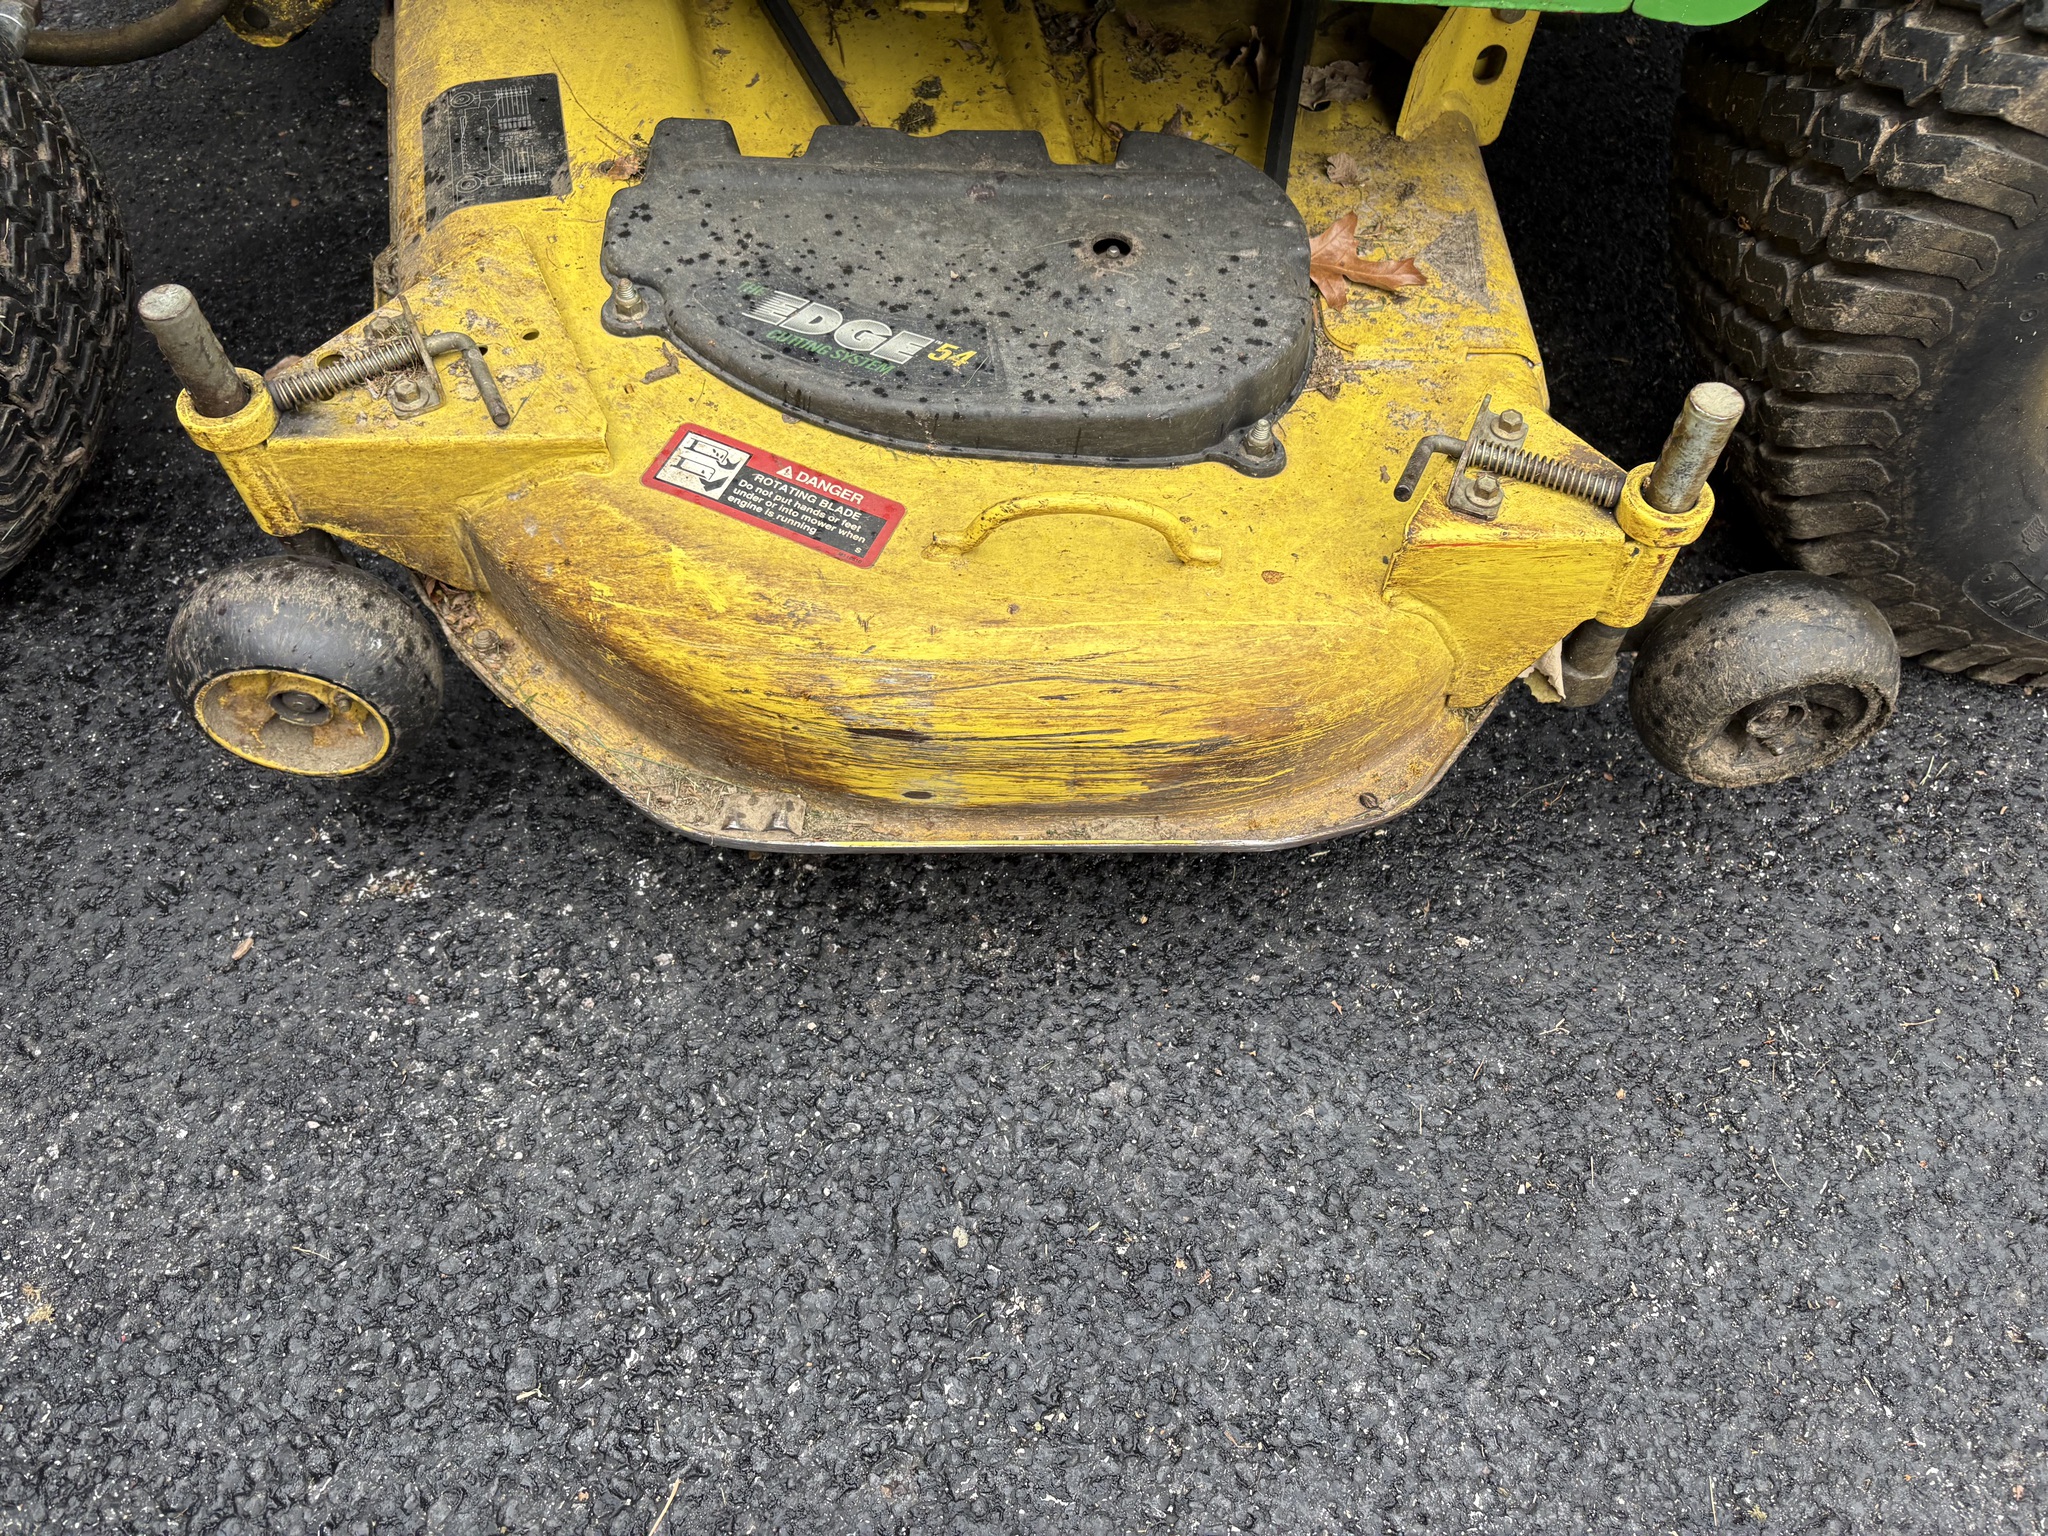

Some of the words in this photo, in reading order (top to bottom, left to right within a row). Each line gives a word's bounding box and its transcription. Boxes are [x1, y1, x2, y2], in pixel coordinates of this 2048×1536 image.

[738, 281, 767, 297] THE
[742, 290, 935, 365] EDGE
[928, 343, 977, 367] 54
[766, 329, 833, 355] CUTTING
[830, 348, 896, 375] SYSTEM
[738, 479, 754, 490] Do
[755, 487, 774, 498] not
[773, 494, 793, 506] put
[793, 501, 826, 518] hands
[828, 515, 840, 523] or
[841, 519, 862, 532] feet
[754, 473, 818, 504] ROTATING
[819, 499, 862, 521] BLADE
[795, 471, 864, 505] DANGER
[727, 495, 763, 513] engine
[764, 508, 775, 518] is
[776, 514, 818, 535] running
[733, 488, 765, 503] under
[765, 501, 778, 509] or
[778, 504, 799, 517] into
[801, 514, 837, 531] mower
[838, 528, 866, 544] when
